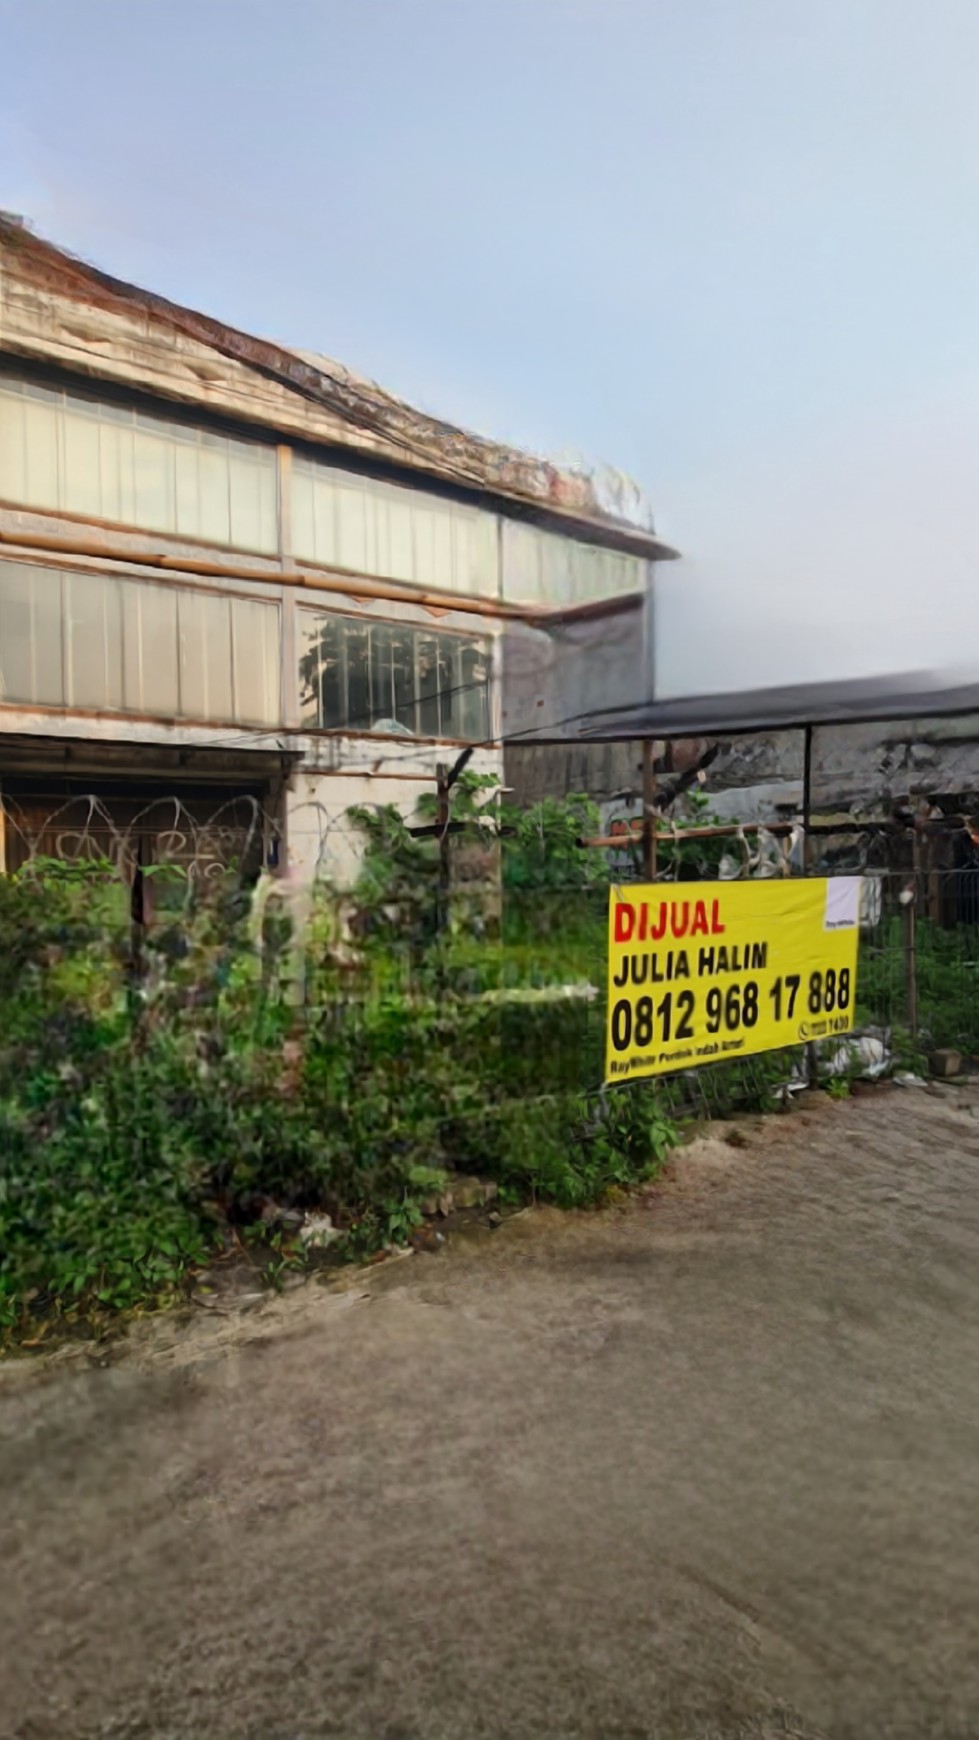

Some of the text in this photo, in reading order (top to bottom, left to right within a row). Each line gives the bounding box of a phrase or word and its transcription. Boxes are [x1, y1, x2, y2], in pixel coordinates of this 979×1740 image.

[614, 899, 725, 943] DIJUAL
[613, 949, 690, 987] JULIA
[611, 968, 849, 1051] 0812 968 17 888
